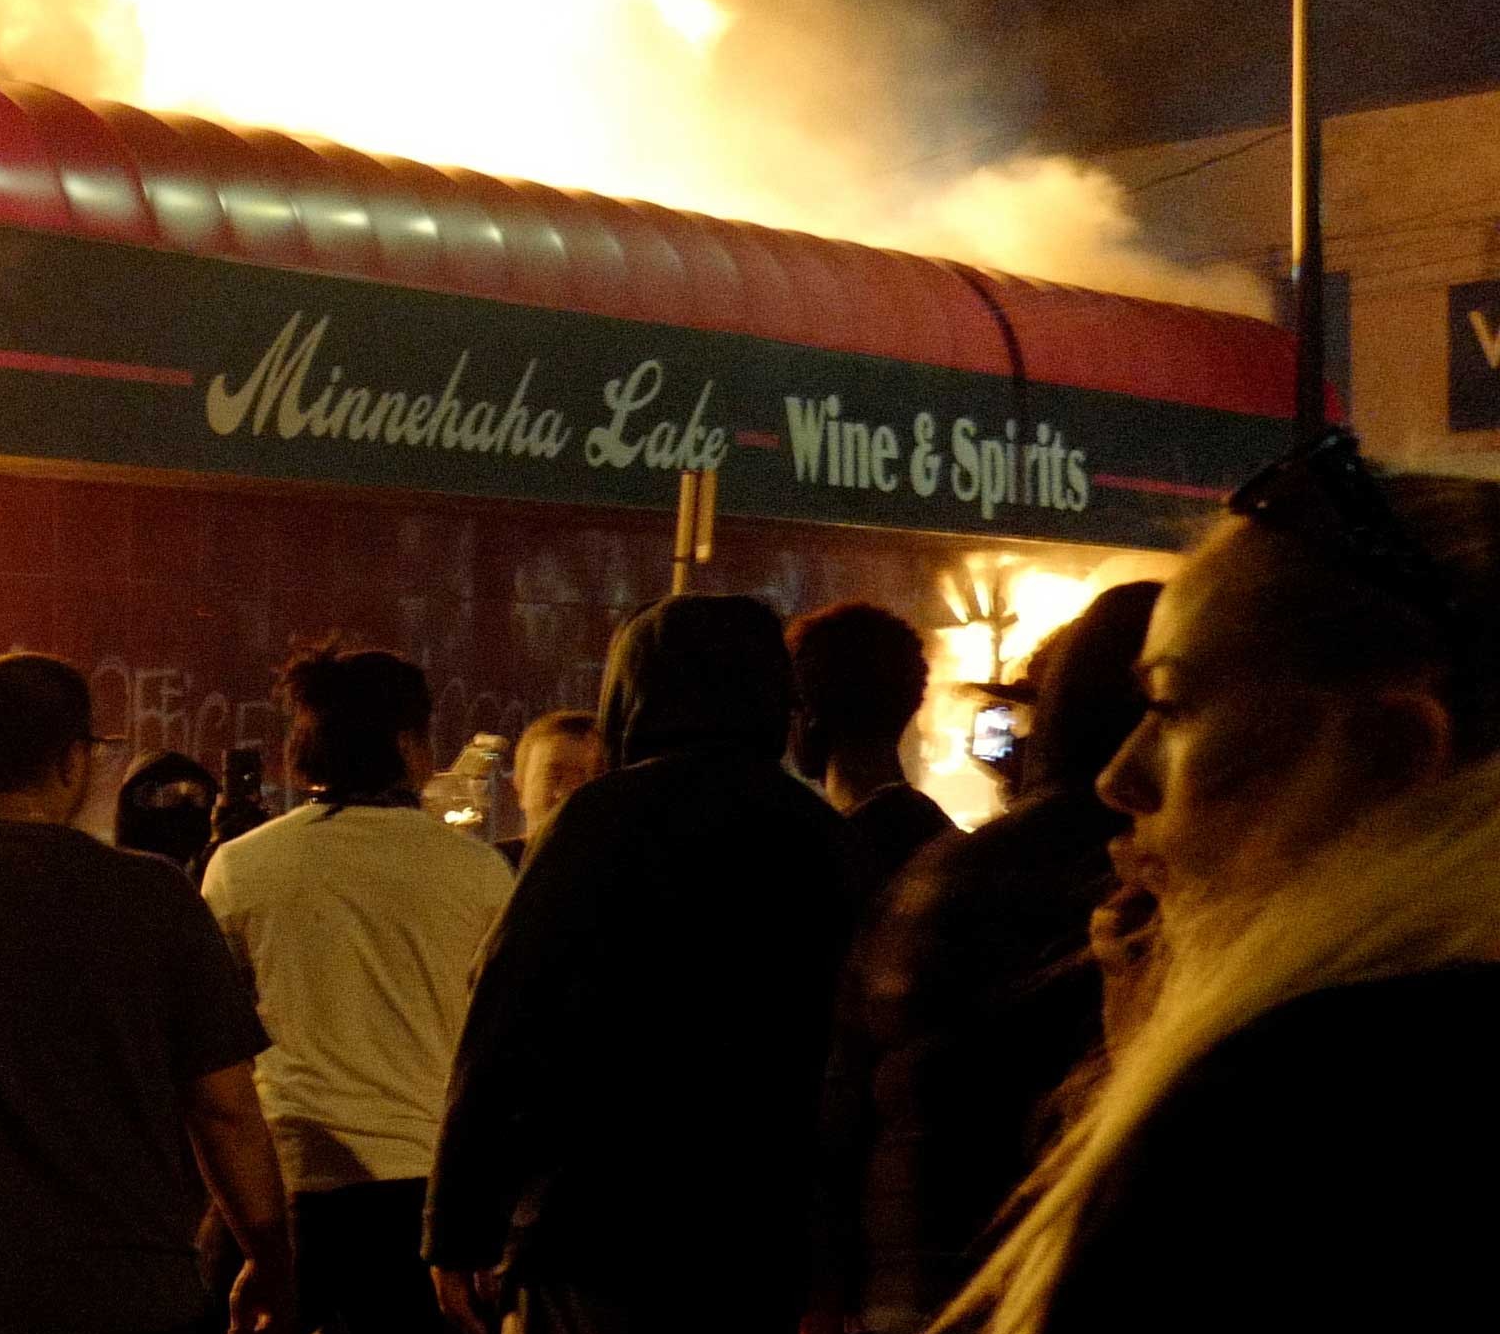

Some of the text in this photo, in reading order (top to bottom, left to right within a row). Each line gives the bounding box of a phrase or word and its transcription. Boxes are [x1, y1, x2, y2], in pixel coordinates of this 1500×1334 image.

[206, 310, 1090, 521] Minnehaha Lake Wine & Spirits
